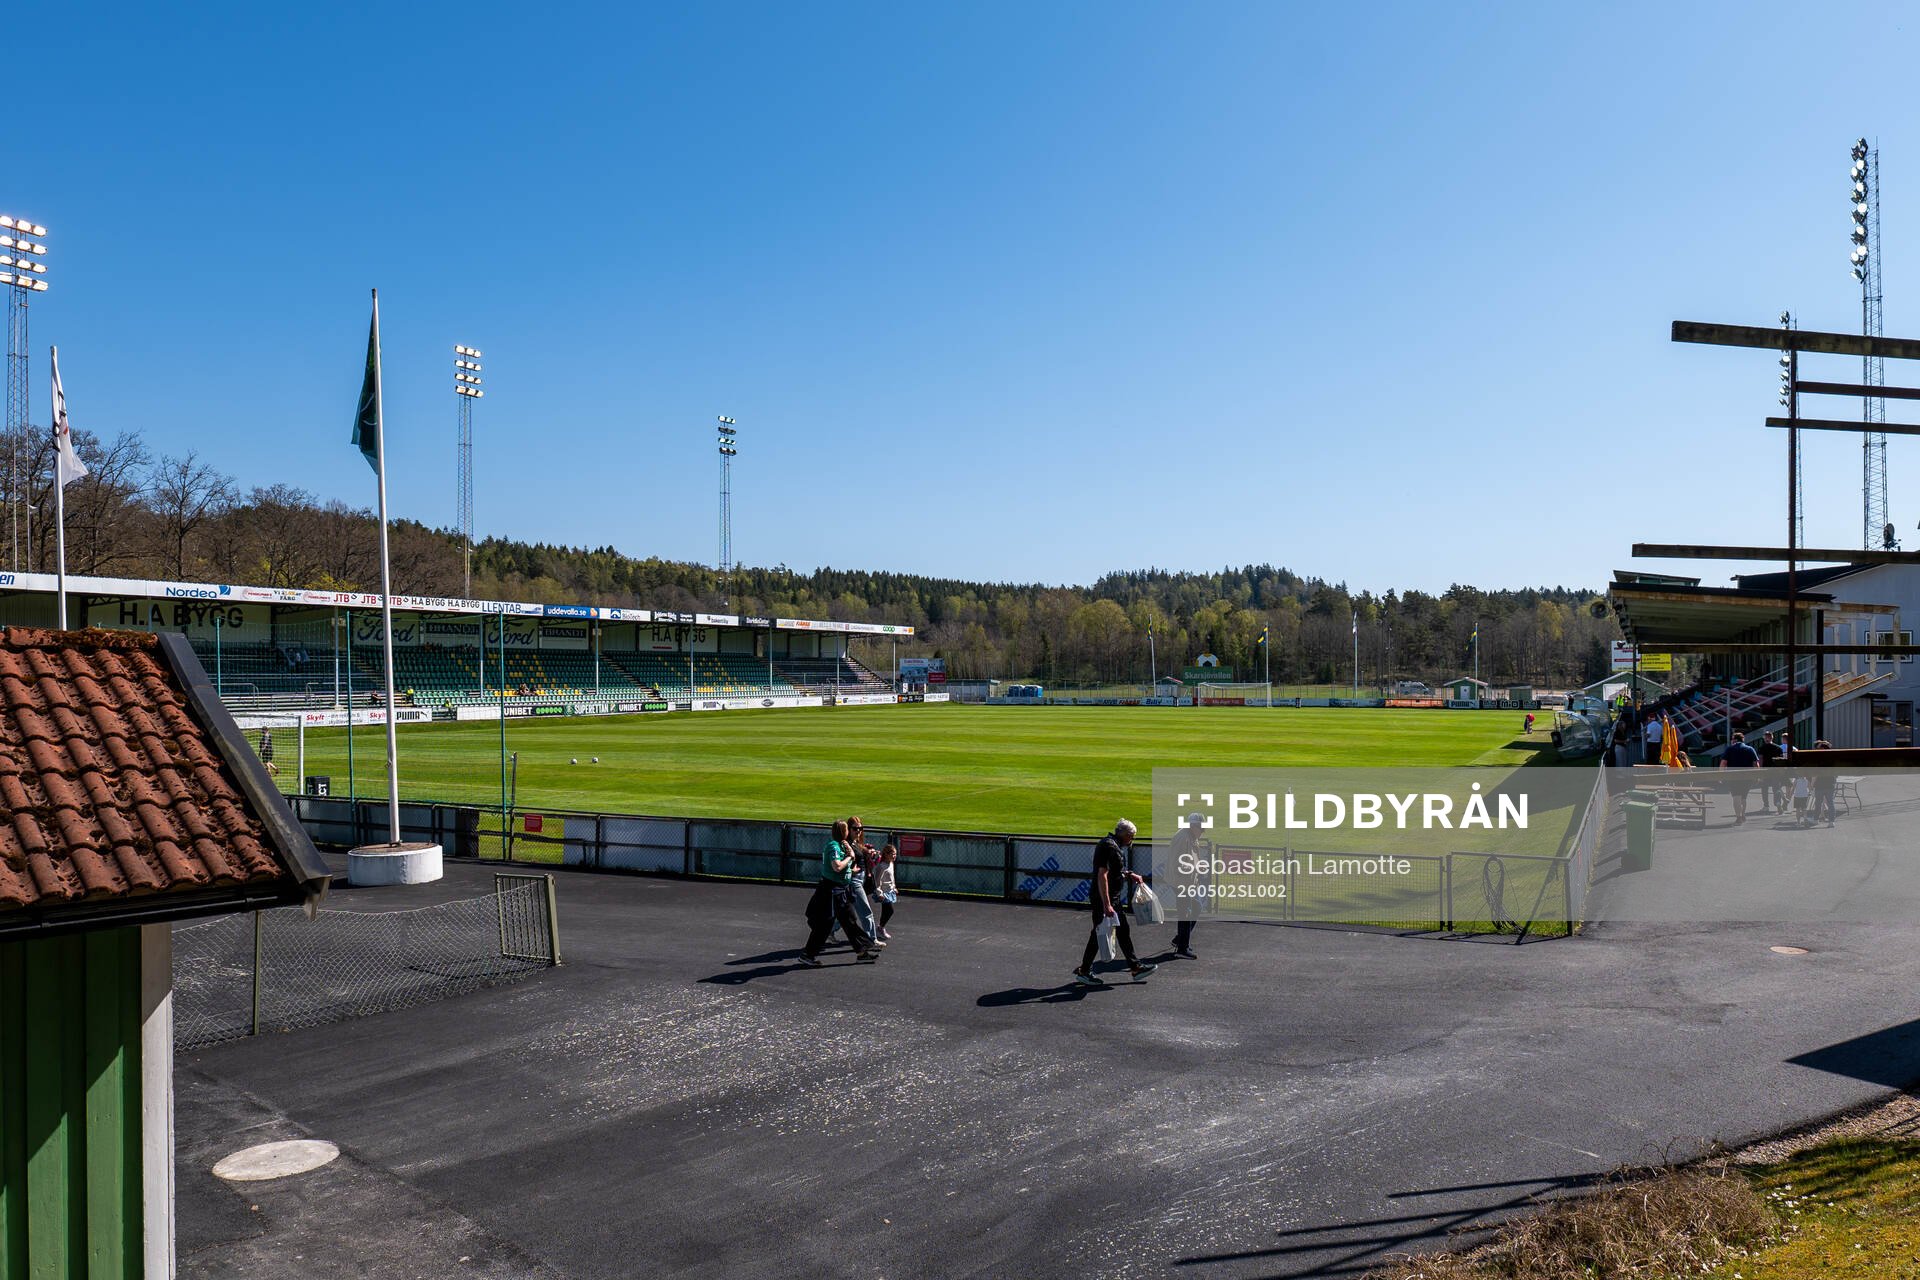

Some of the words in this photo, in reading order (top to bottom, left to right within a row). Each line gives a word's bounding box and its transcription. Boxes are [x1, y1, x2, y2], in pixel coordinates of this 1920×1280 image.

[166, 586, 217, 598] Nordea
[334, 594, 350, 603] JTB
[361, 595, 377, 605] JTB
[411, 597, 424, 606] H.A
[425, 598, 446, 607] BYGG
[448, 600, 460, 608] H.A
[461, 600, 480, 609] BYGG
[482, 602, 522, 614] LLENTAB
[120, 602, 165, 627] H.A
[174, 602, 244, 628] BYGG
[547, 607, 587, 616] uddevalla.se
[487, 616, 535, 645] Ford
[675, 625, 706, 643] BYGG
[573, 703, 609, 715] SUPERETTAN
[618, 703, 642, 711] UNIBET
[702, 701, 717, 709] PUMA
[396, 711, 420, 721] PUMA
[503, 707, 533, 716] UNIBET
[306, 713, 325, 722] Skylt
